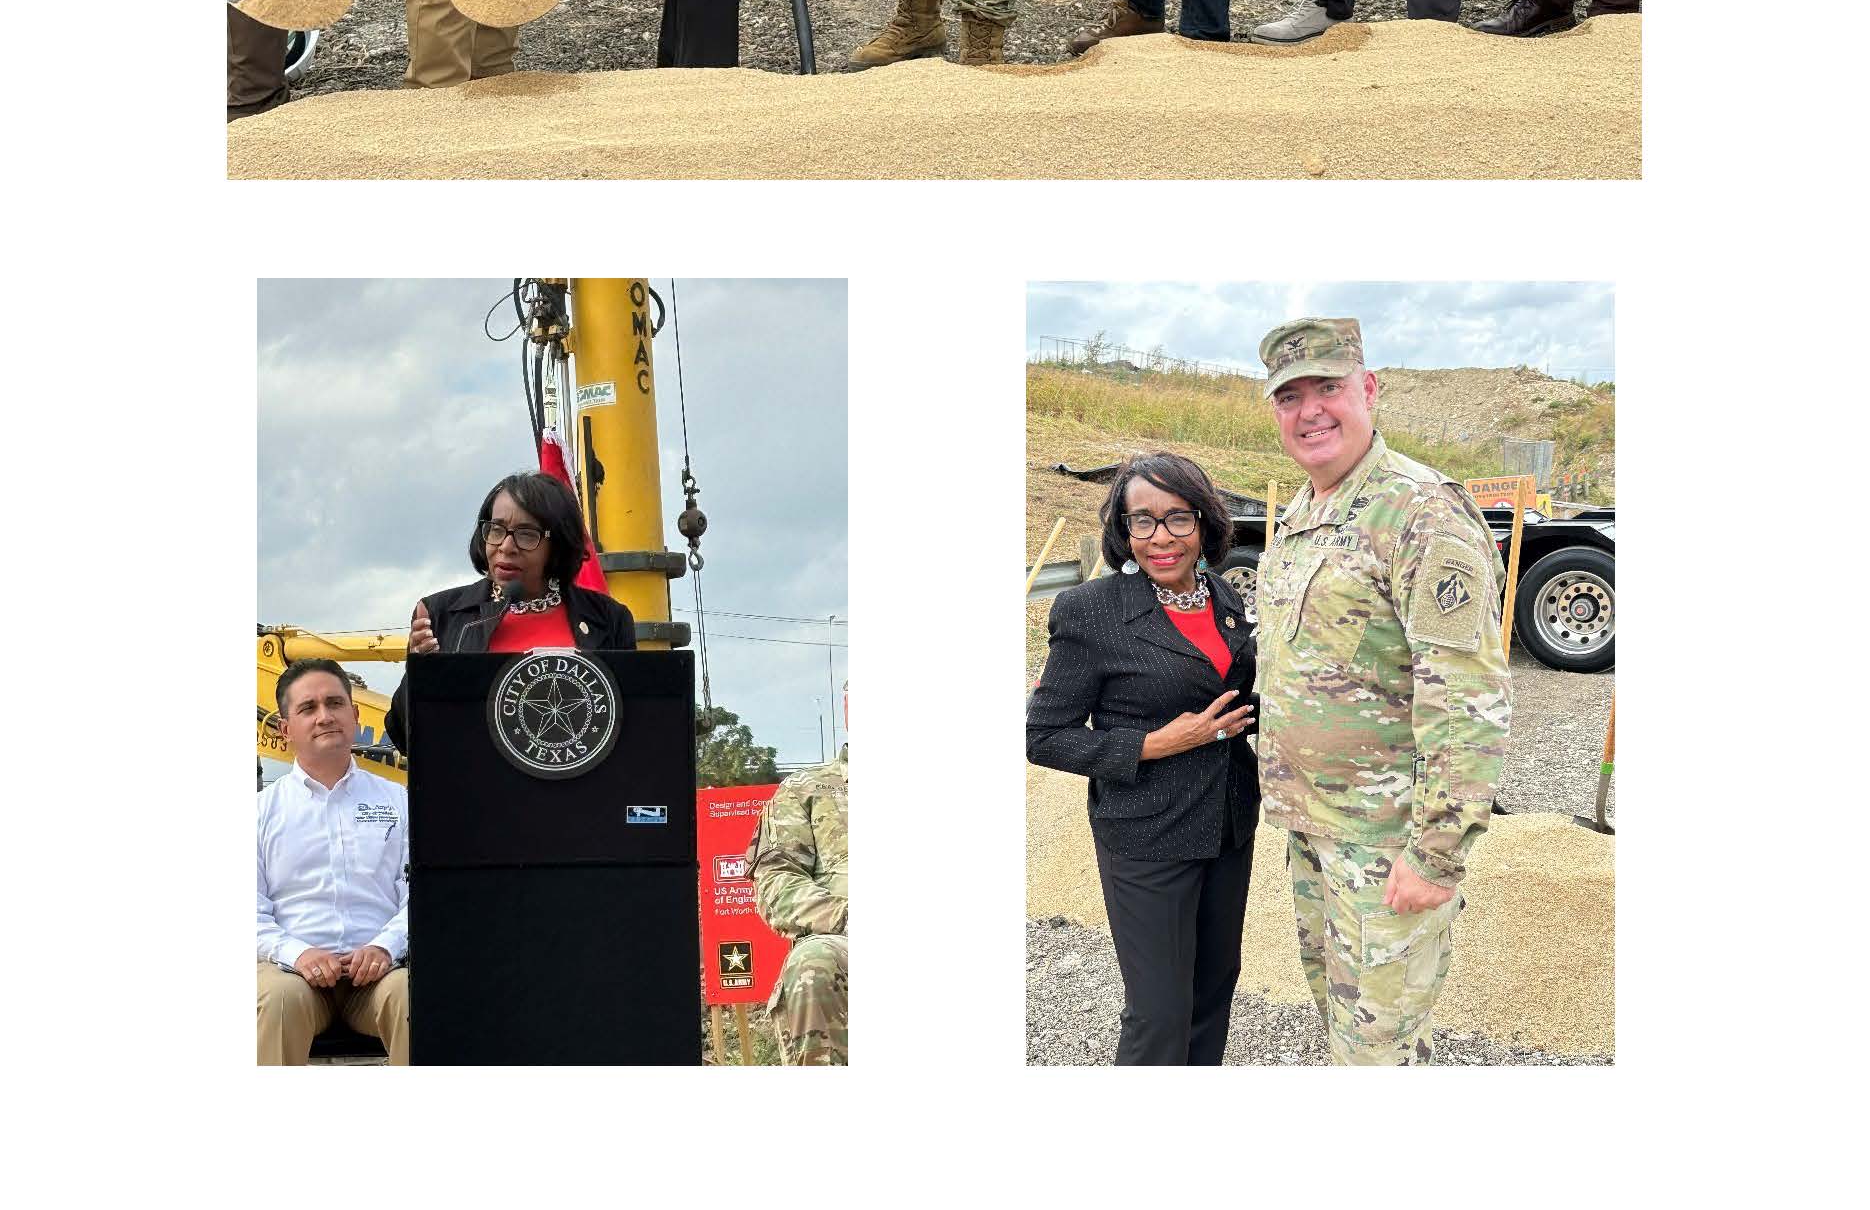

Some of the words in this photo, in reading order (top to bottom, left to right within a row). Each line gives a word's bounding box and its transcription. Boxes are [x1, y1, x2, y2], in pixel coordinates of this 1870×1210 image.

[1472, 481, 1530, 494] DANGE
[1329, 535, 1353, 547] ARMY
[503, 672, 526, 716] CITY
[527, 659, 549, 677] OF
[556, 658, 607, 714] DALLAS
[525, 739, 588, 763] TEXAS
[710, 800, 735, 810] Design
[736, 800, 750, 808] and
[752, 799, 770, 807] Con
[710, 809, 750, 818] Supervised
[714, 886, 727, 895] US
[730, 886, 753, 896] Army
[715, 895, 724, 905] of
[715, 907, 730, 916] Fort
[731, 906, 752, 916] Worth
